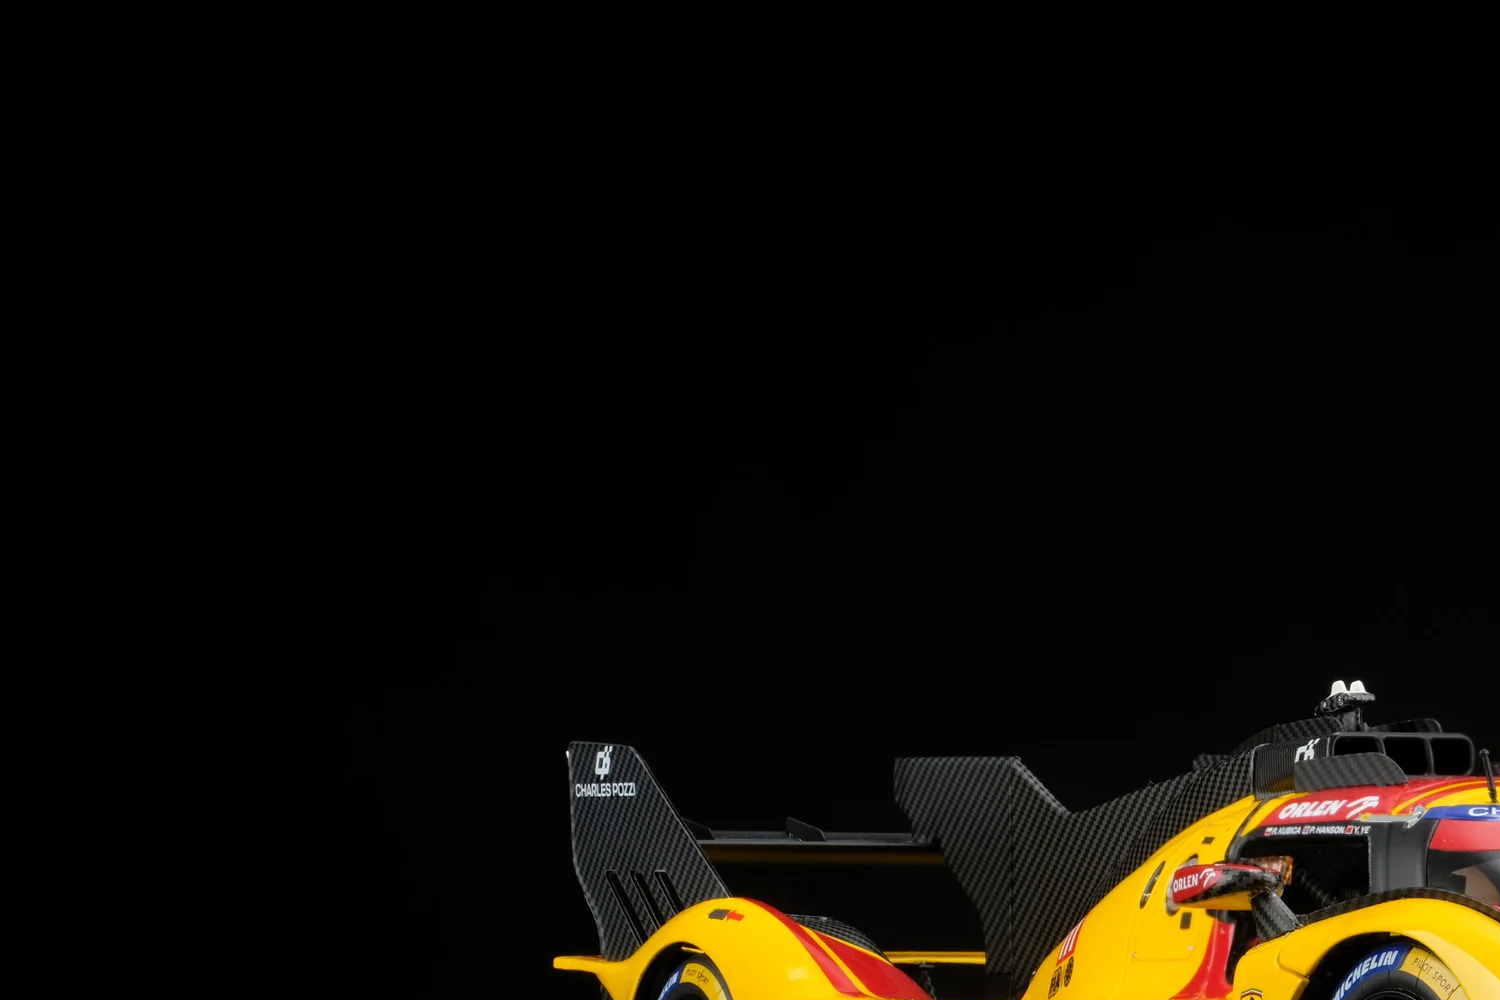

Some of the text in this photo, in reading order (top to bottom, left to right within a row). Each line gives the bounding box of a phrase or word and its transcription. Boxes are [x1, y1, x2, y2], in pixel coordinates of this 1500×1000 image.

[575, 783, 636, 797] CHARLES POZZI
[1278, 799, 1348, 819] ORLEN
[1173, 873, 1199, 892] ORLEN
[1412, 957, 1455, 996] PILOT SPORT
